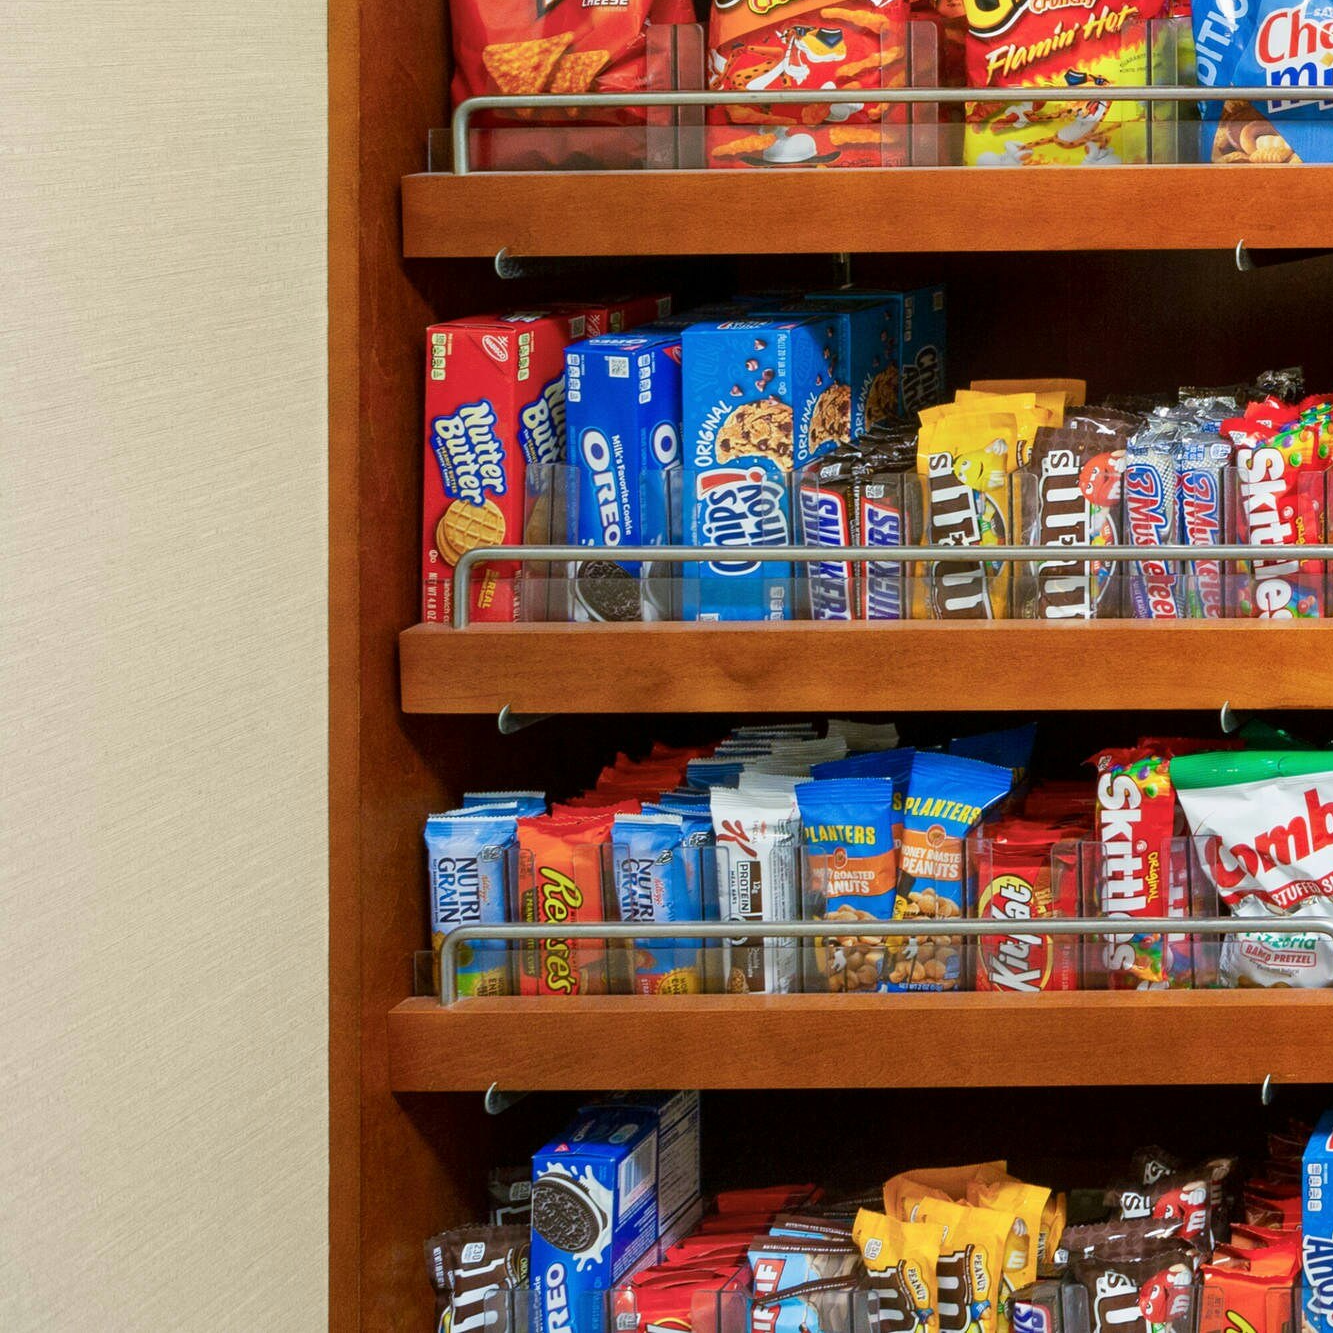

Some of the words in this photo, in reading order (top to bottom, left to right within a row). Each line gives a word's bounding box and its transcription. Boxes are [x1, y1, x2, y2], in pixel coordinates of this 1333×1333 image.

[1083, 6, 1138, 45] Hot
[695, 400, 734, 467] ORIGINAL
[798, 392, 819, 459] ORIGINAL
[435, 415, 483, 504] Butter
[459, 401, 504, 493] Nutter
[583, 430, 620, 546] OREO
[617, 465, 630, 505] Favorite
[622, 505, 634, 536] Cookie
[903, 796, 982, 825] PLANTERS
[740, 863, 749, 911] PROTEIN
[833, 870, 875, 880] ROASTED
[902, 857, 959, 878] PEANUTS
[438, 856, 461, 923] GRAIN
[455, 856, 480, 923] NUTRI
[1272, 882, 1321, 906] STUFFED
[907, 1267, 926, 1301] PEANUT
[974, 1253, 988, 1293] PEANUT
